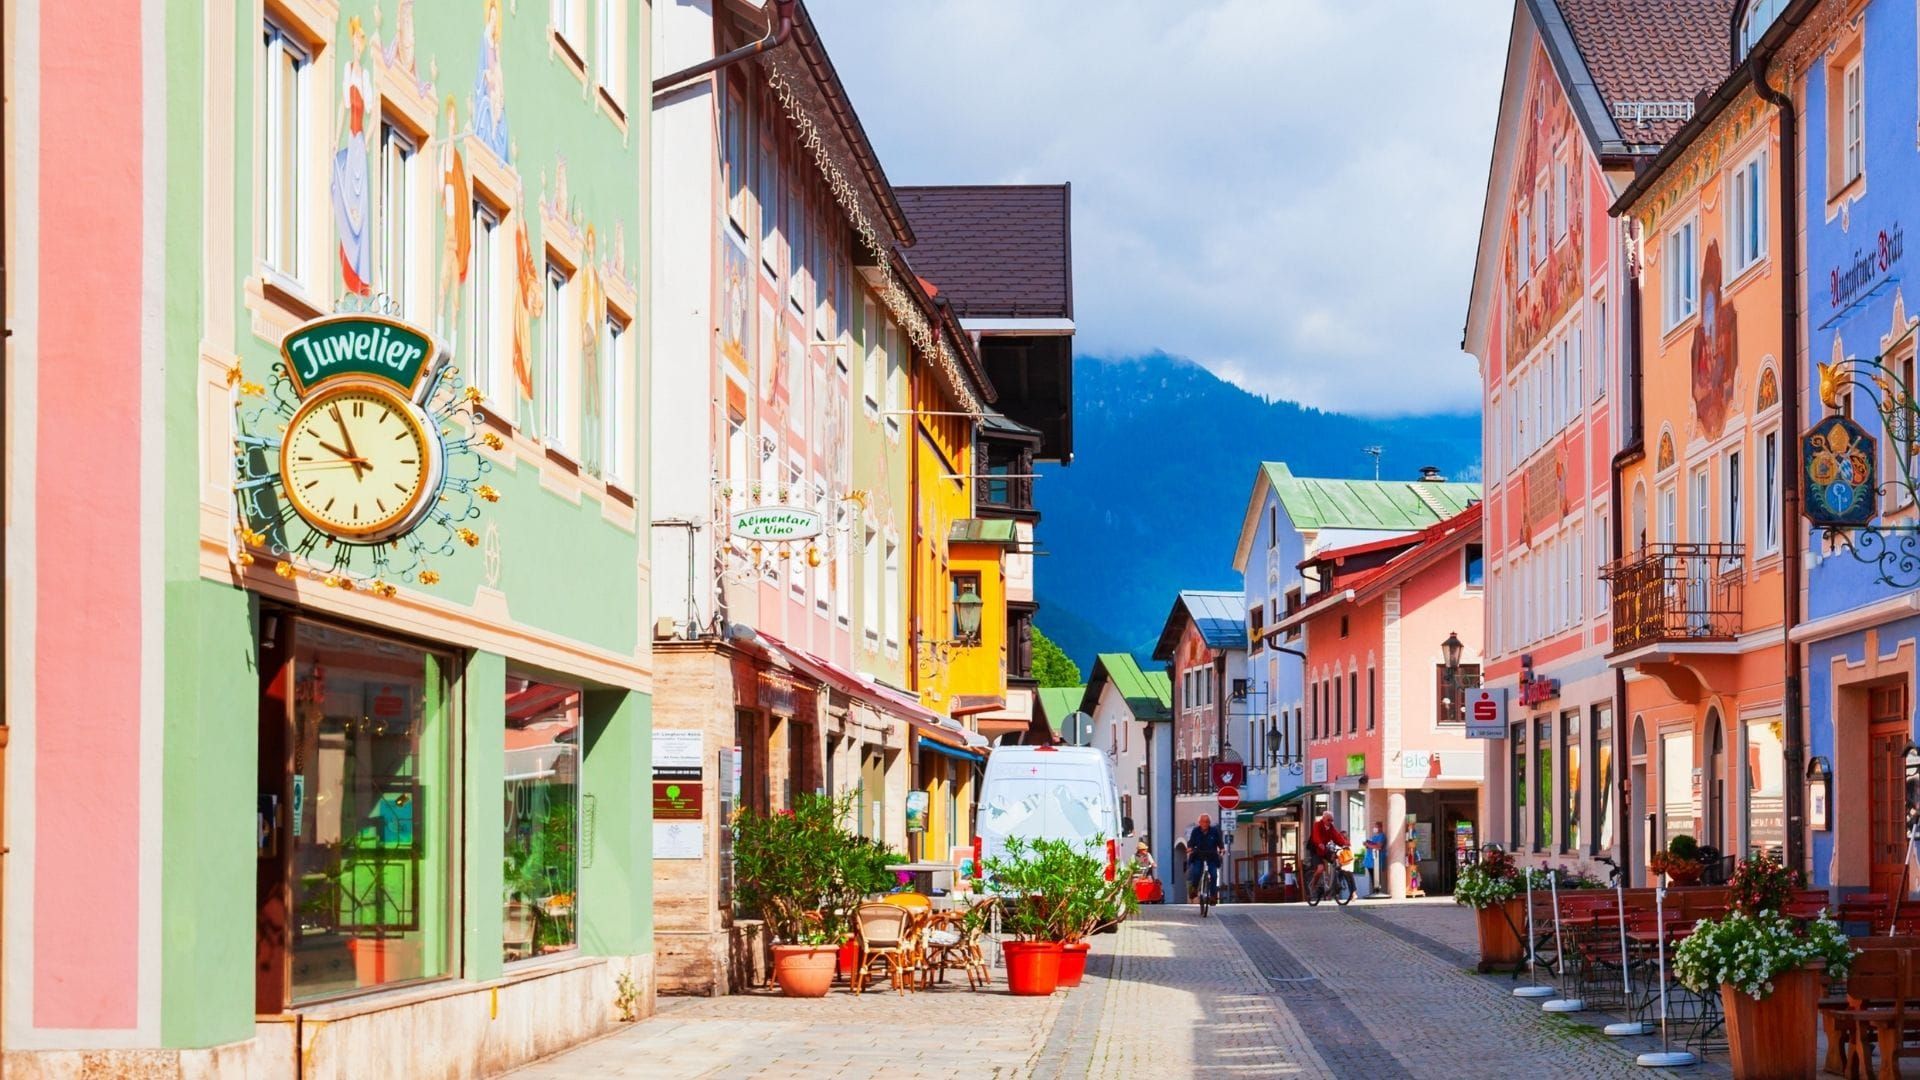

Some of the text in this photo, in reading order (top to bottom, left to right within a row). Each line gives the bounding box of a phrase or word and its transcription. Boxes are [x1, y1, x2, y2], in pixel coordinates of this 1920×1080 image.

[1831, 221, 1903, 308] Augustiner Bräu
[292, 327, 421, 379] Juwelier
[738, 514, 811, 529] Alimentari
[753, 525, 793, 535] & Vino
